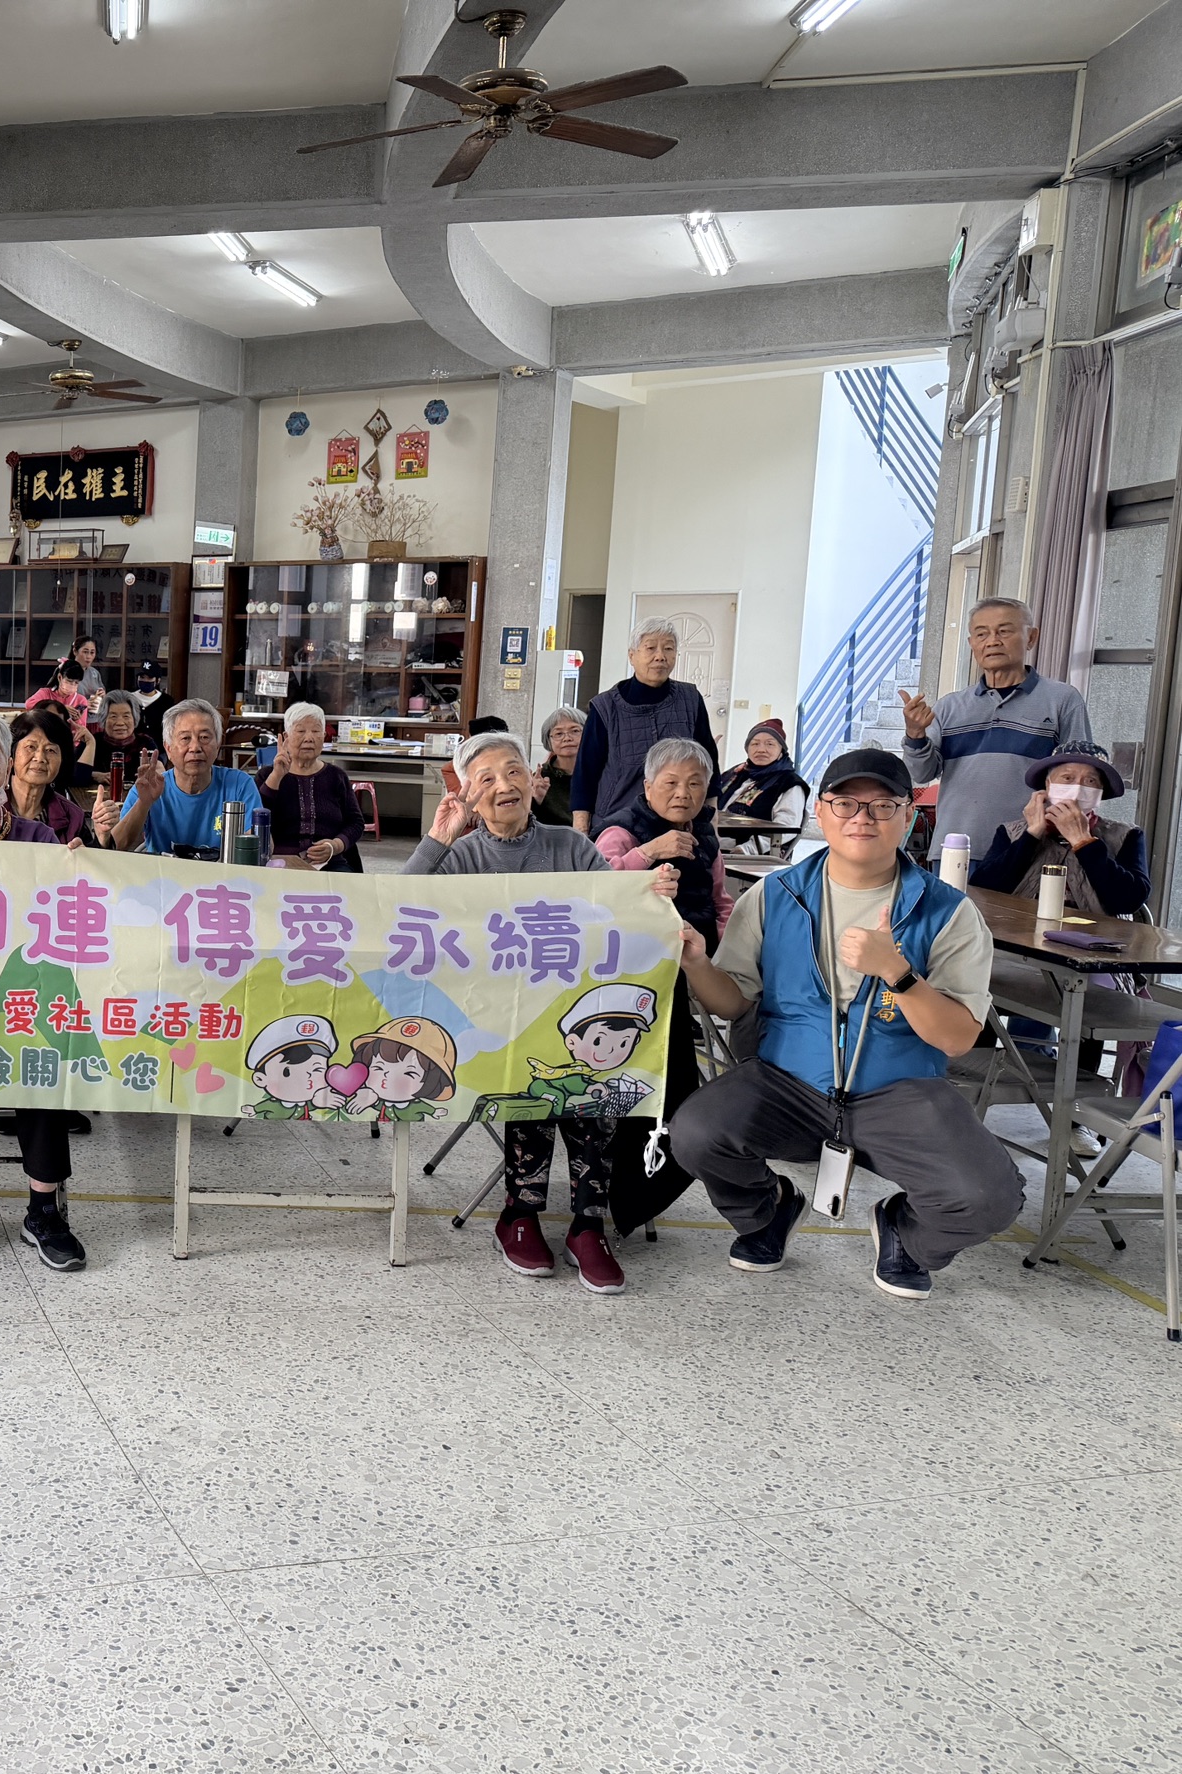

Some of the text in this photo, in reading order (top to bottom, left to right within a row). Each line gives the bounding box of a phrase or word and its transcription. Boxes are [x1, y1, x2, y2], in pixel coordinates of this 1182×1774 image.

[200, 626, 219, 647] 19
[300, 1022, 318, 1036] 郵
[402, 1022, 419, 1037] 郵
